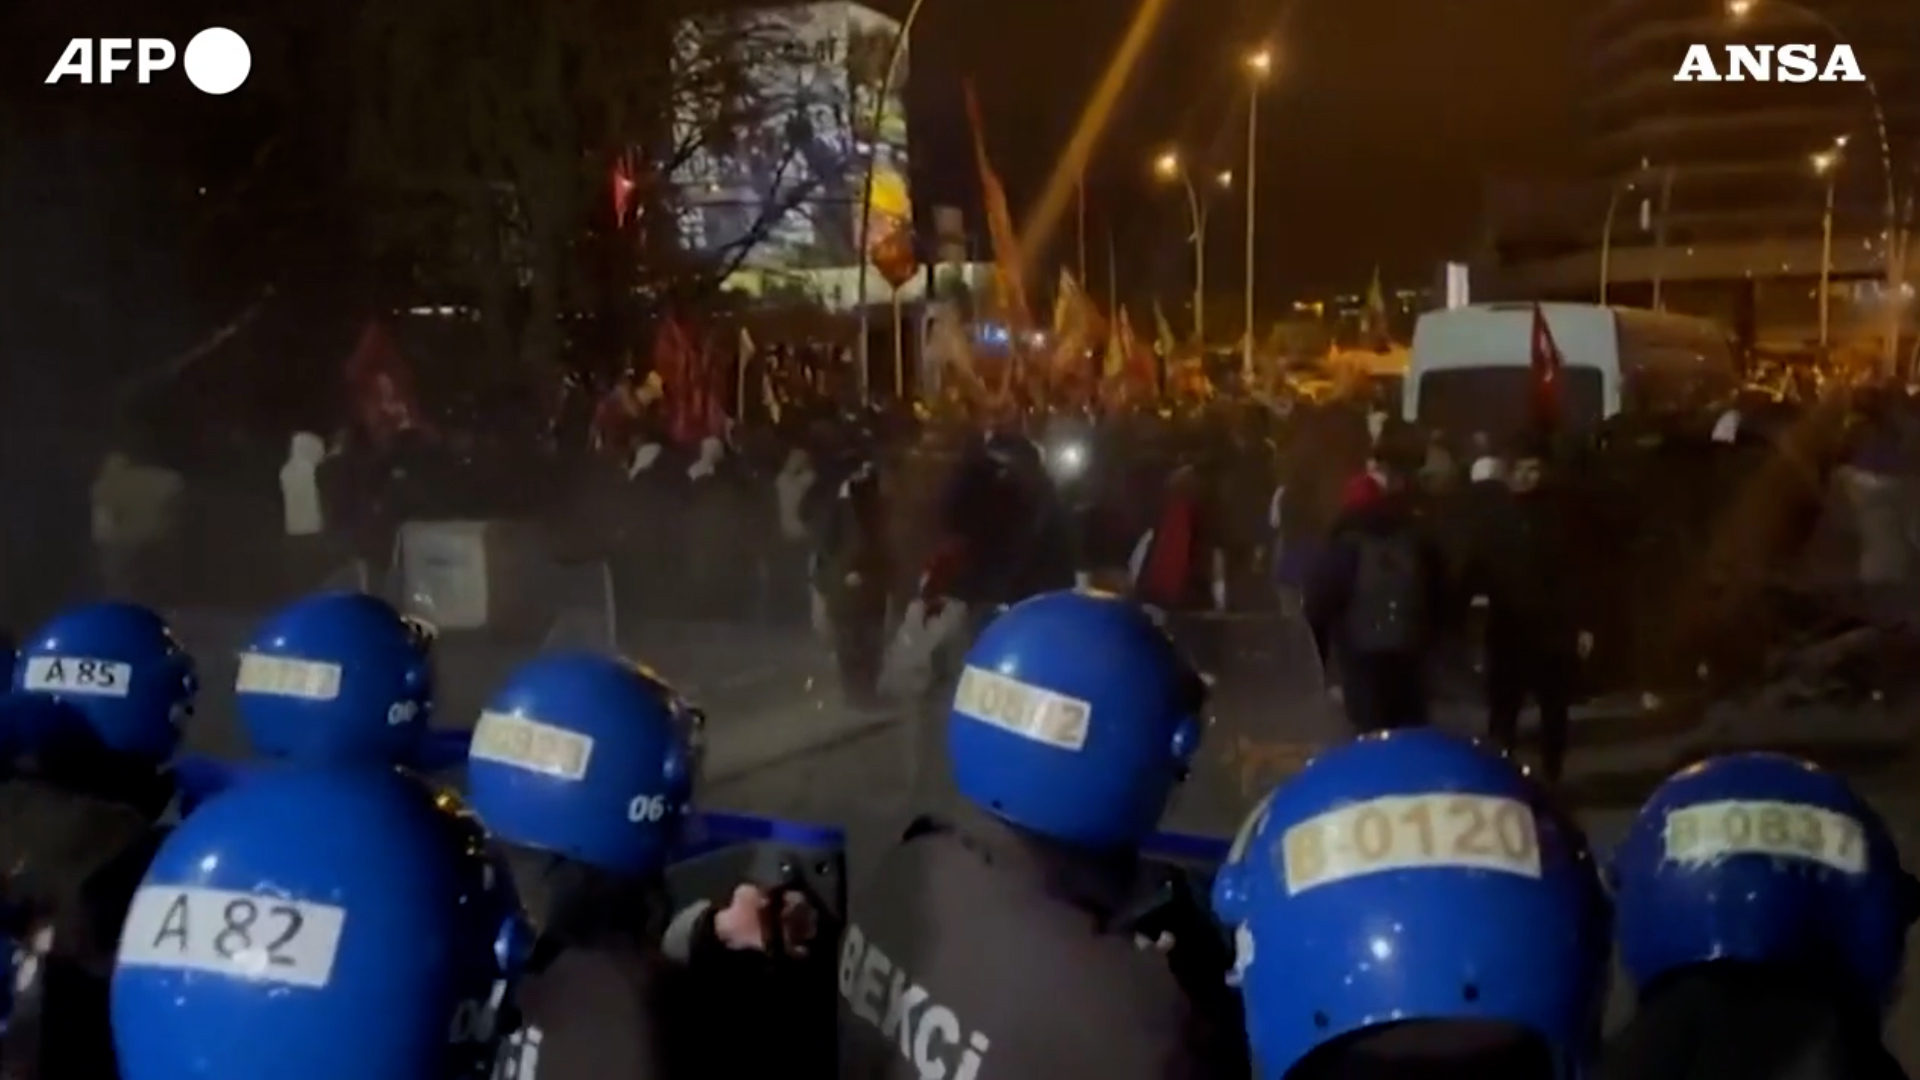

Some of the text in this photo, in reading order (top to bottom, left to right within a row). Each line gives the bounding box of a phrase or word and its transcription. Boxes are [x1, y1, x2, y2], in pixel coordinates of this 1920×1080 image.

[45, 658, 115, 687] A 85
[629, 795, 665, 822] 06
[153, 894, 303, 966] A 82
